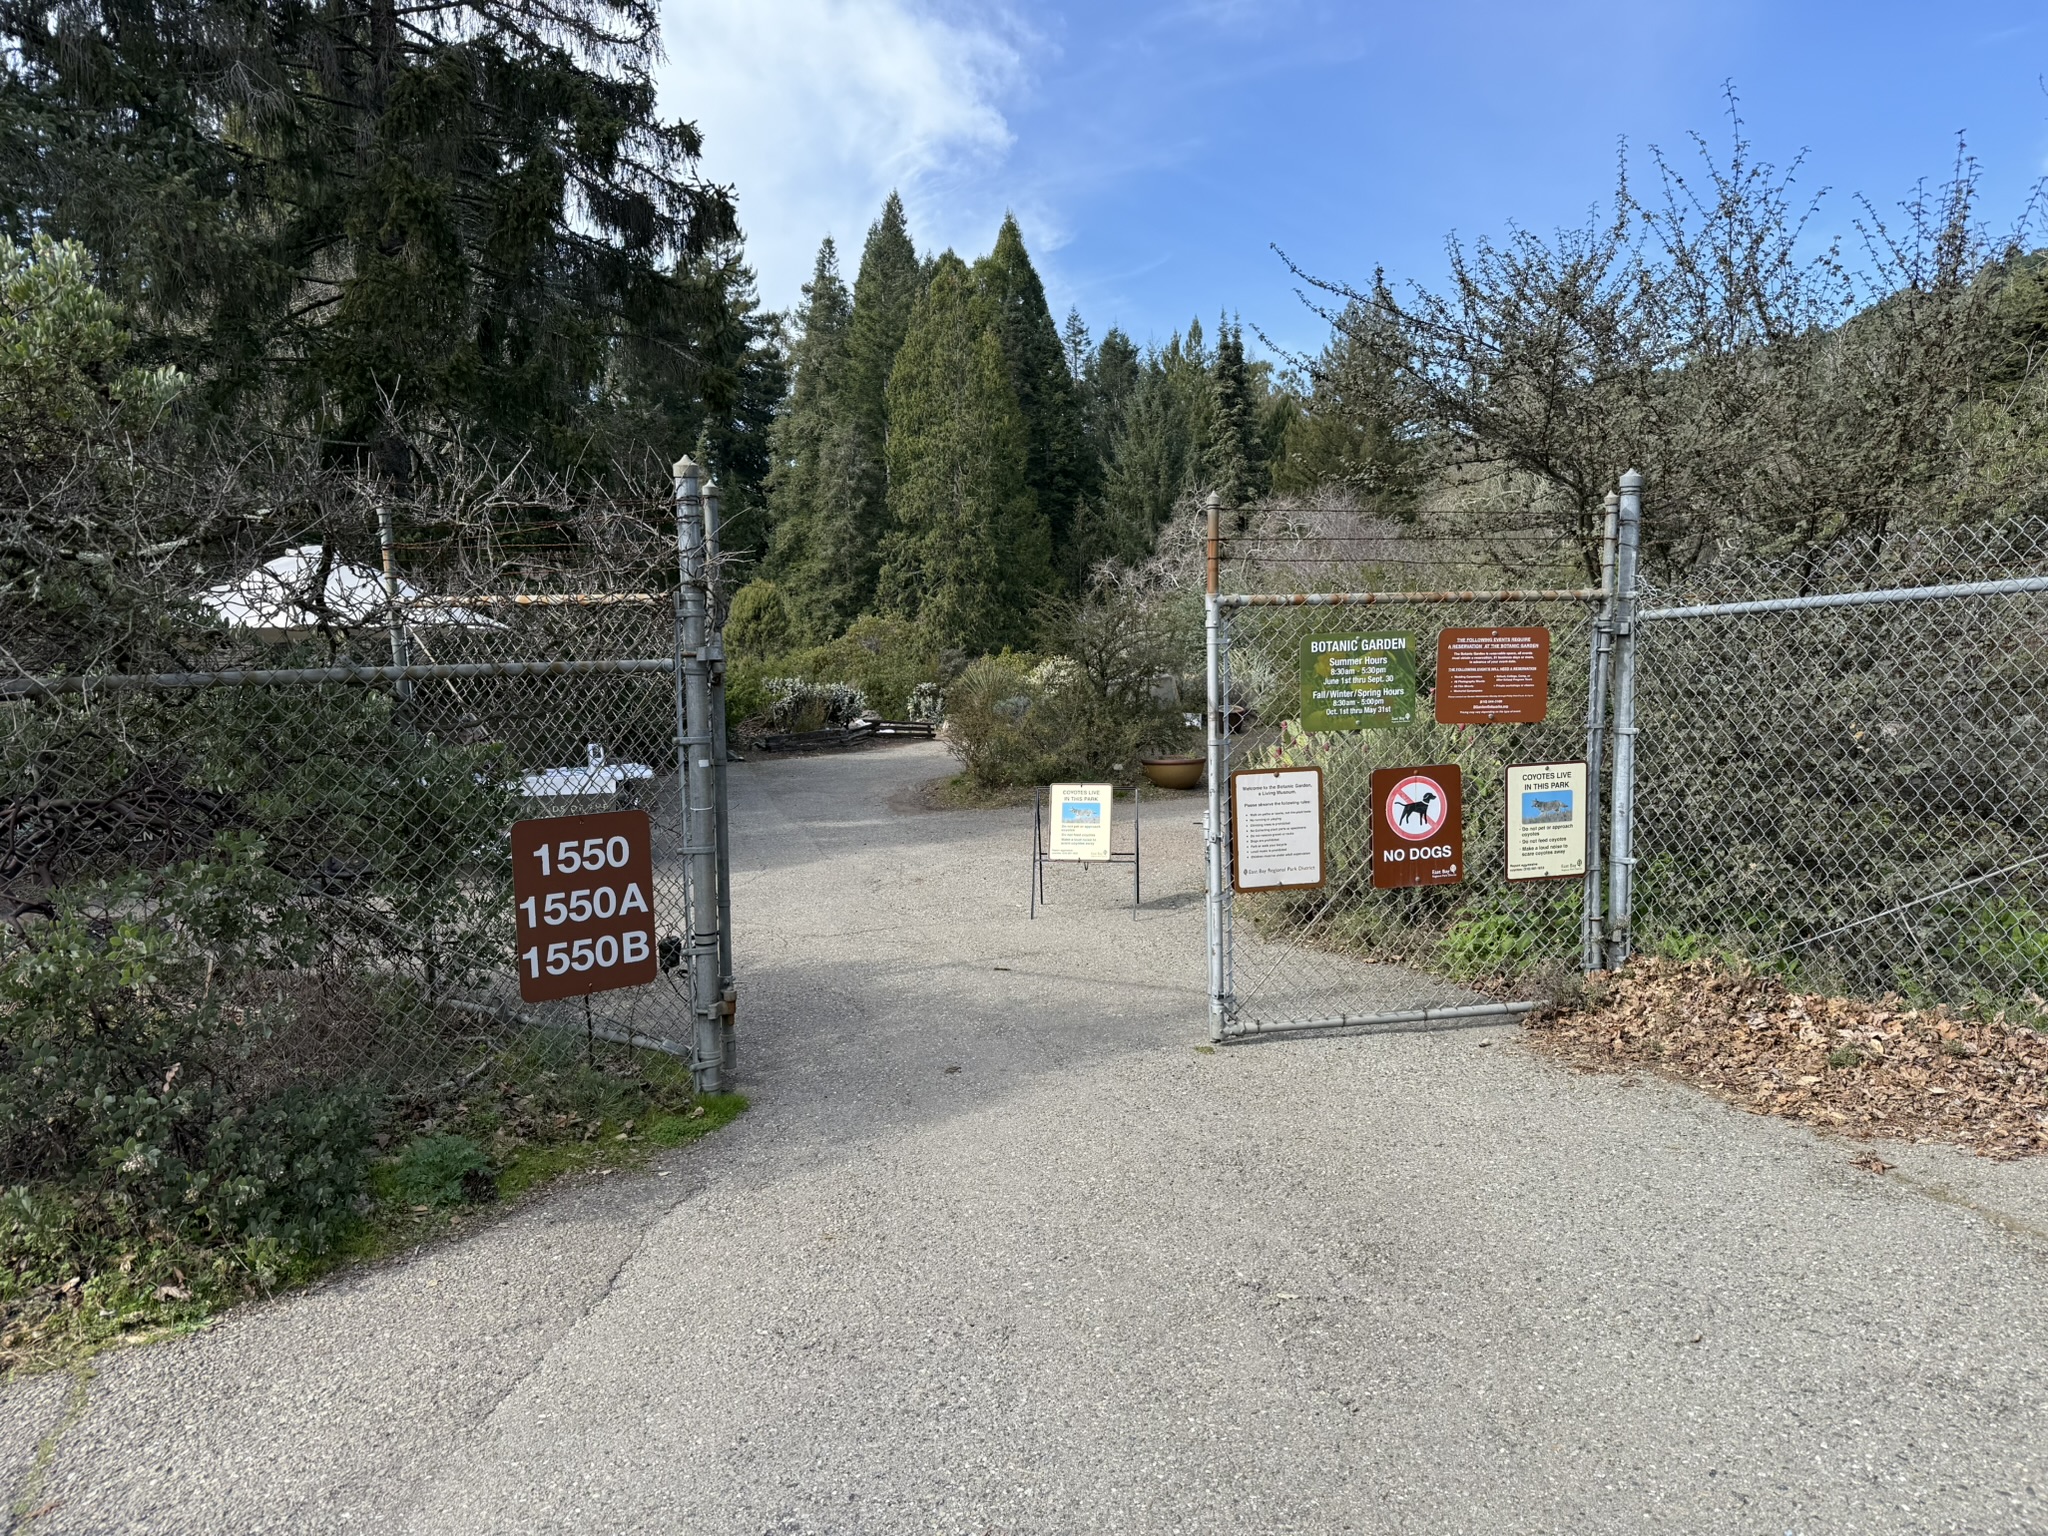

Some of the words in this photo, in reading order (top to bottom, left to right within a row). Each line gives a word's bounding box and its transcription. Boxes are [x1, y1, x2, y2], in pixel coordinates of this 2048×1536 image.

[1311, 640, 1358, 652] BOTANIC
[1362, 638, 1406, 650] GARDEN
[1330, 657, 1362, 666] Summer
[1365, 656, 1387, 665] Hours
[1522, 773, 1554, 781] COYOTES
[533, 836, 630, 876] 1550
[1384, 849, 1405, 862] NO
[1410, 845, 1452, 860] DOGS
[520, 883, 649, 928] 1550A
[522, 930, 650, 978] 1550B
